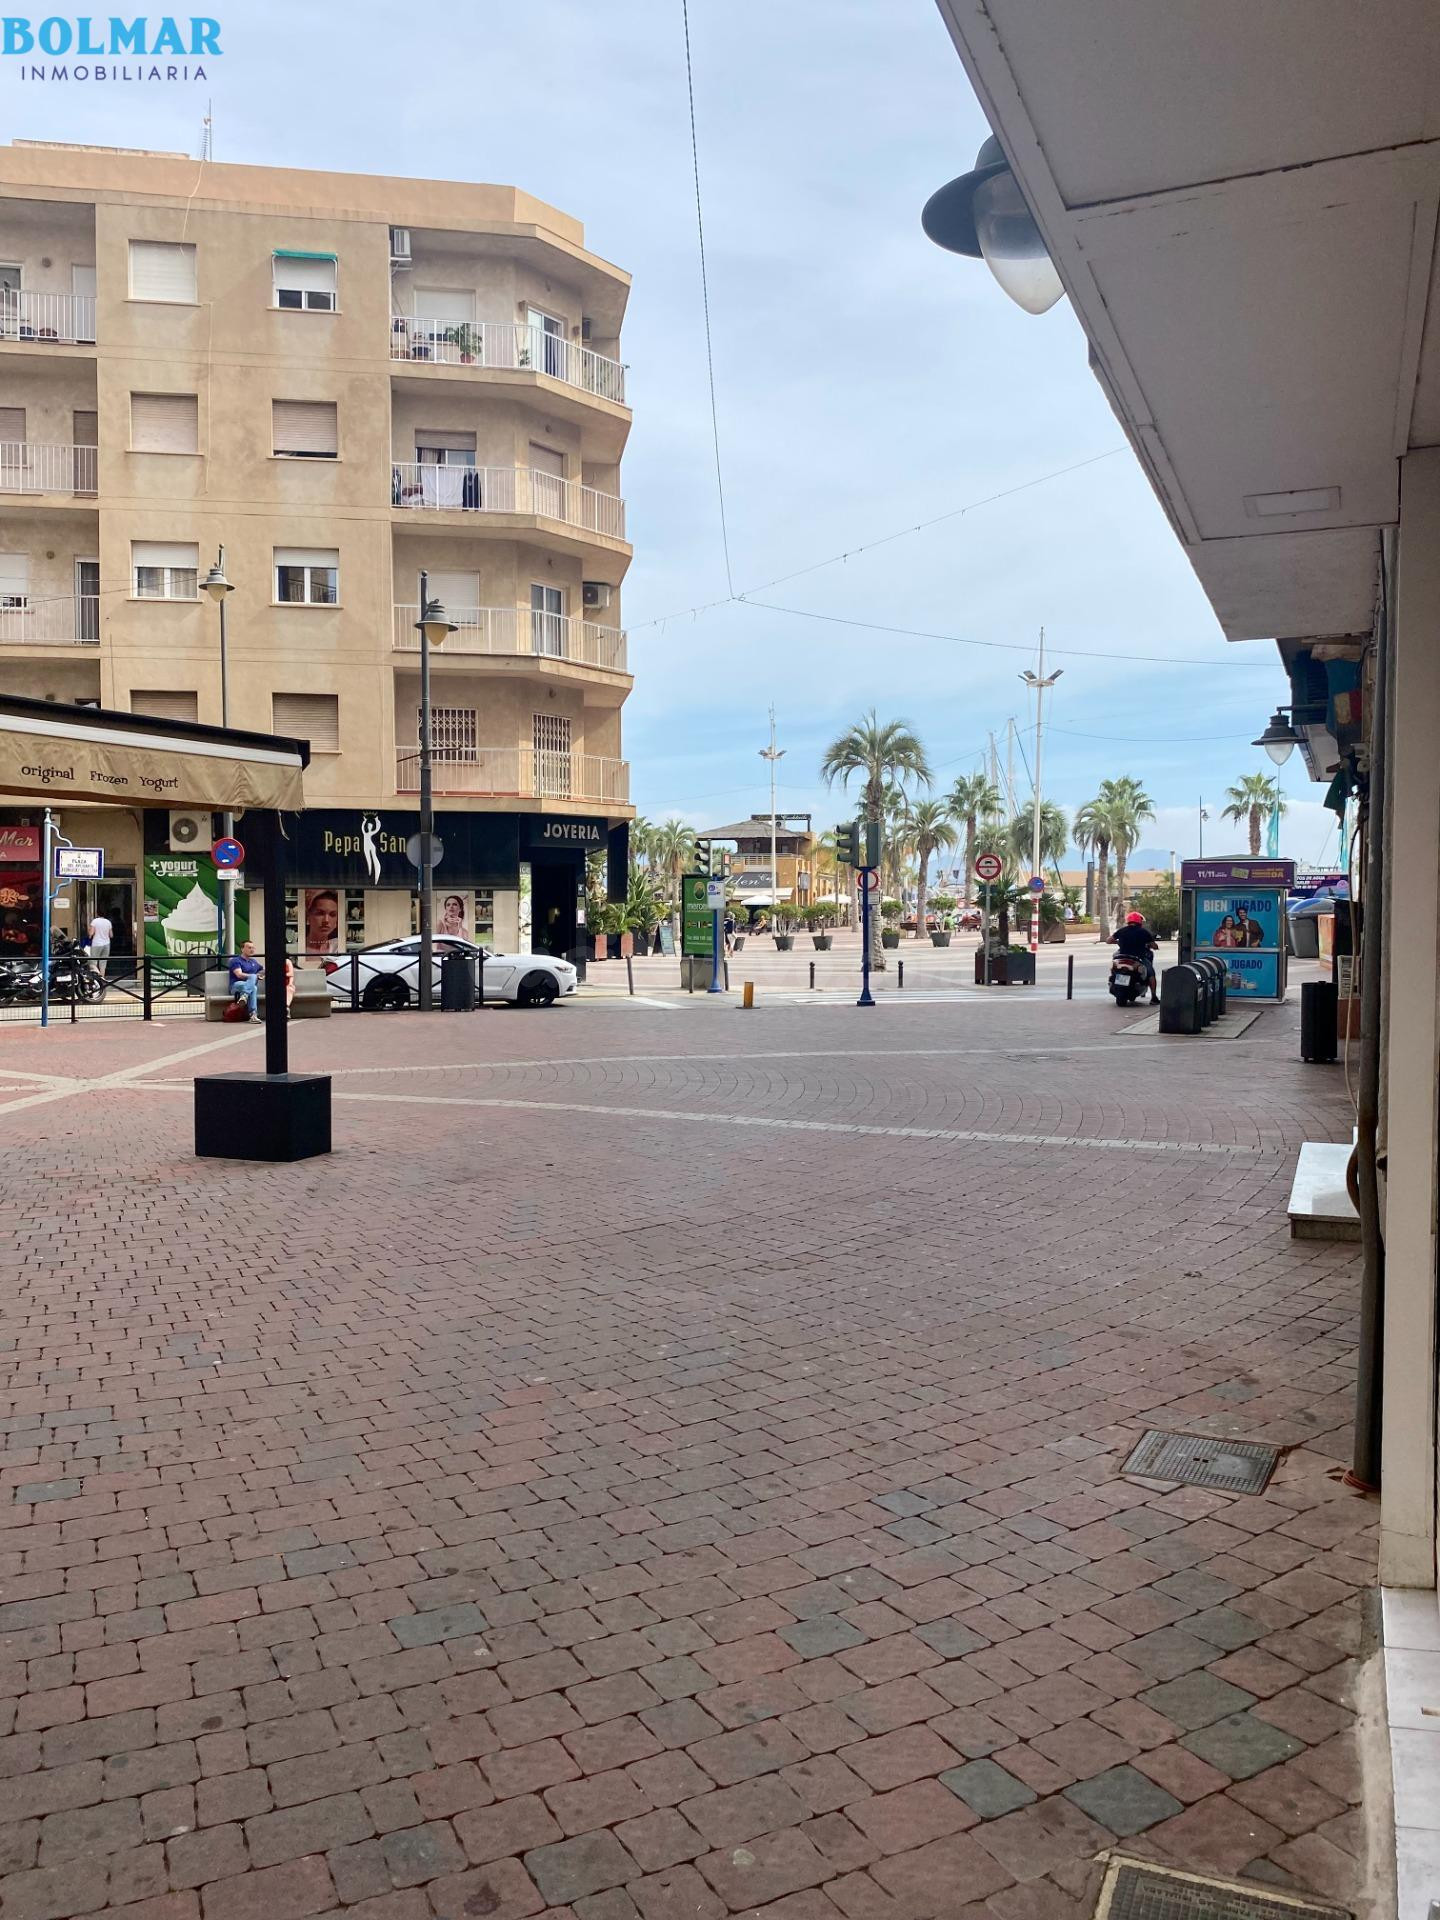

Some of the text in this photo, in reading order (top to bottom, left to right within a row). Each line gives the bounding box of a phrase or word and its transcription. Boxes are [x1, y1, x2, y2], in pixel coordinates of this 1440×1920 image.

[90, 770, 128, 785] Frozen
[139, 776, 179, 793] Yogurt
[543, 823, 600, 840] JOYERIA
[324, 830, 361, 857] Pepa
[1203, 899, 1272, 913] BIEN JUGADO
[1230, 959, 1263, 970] JUGADO
